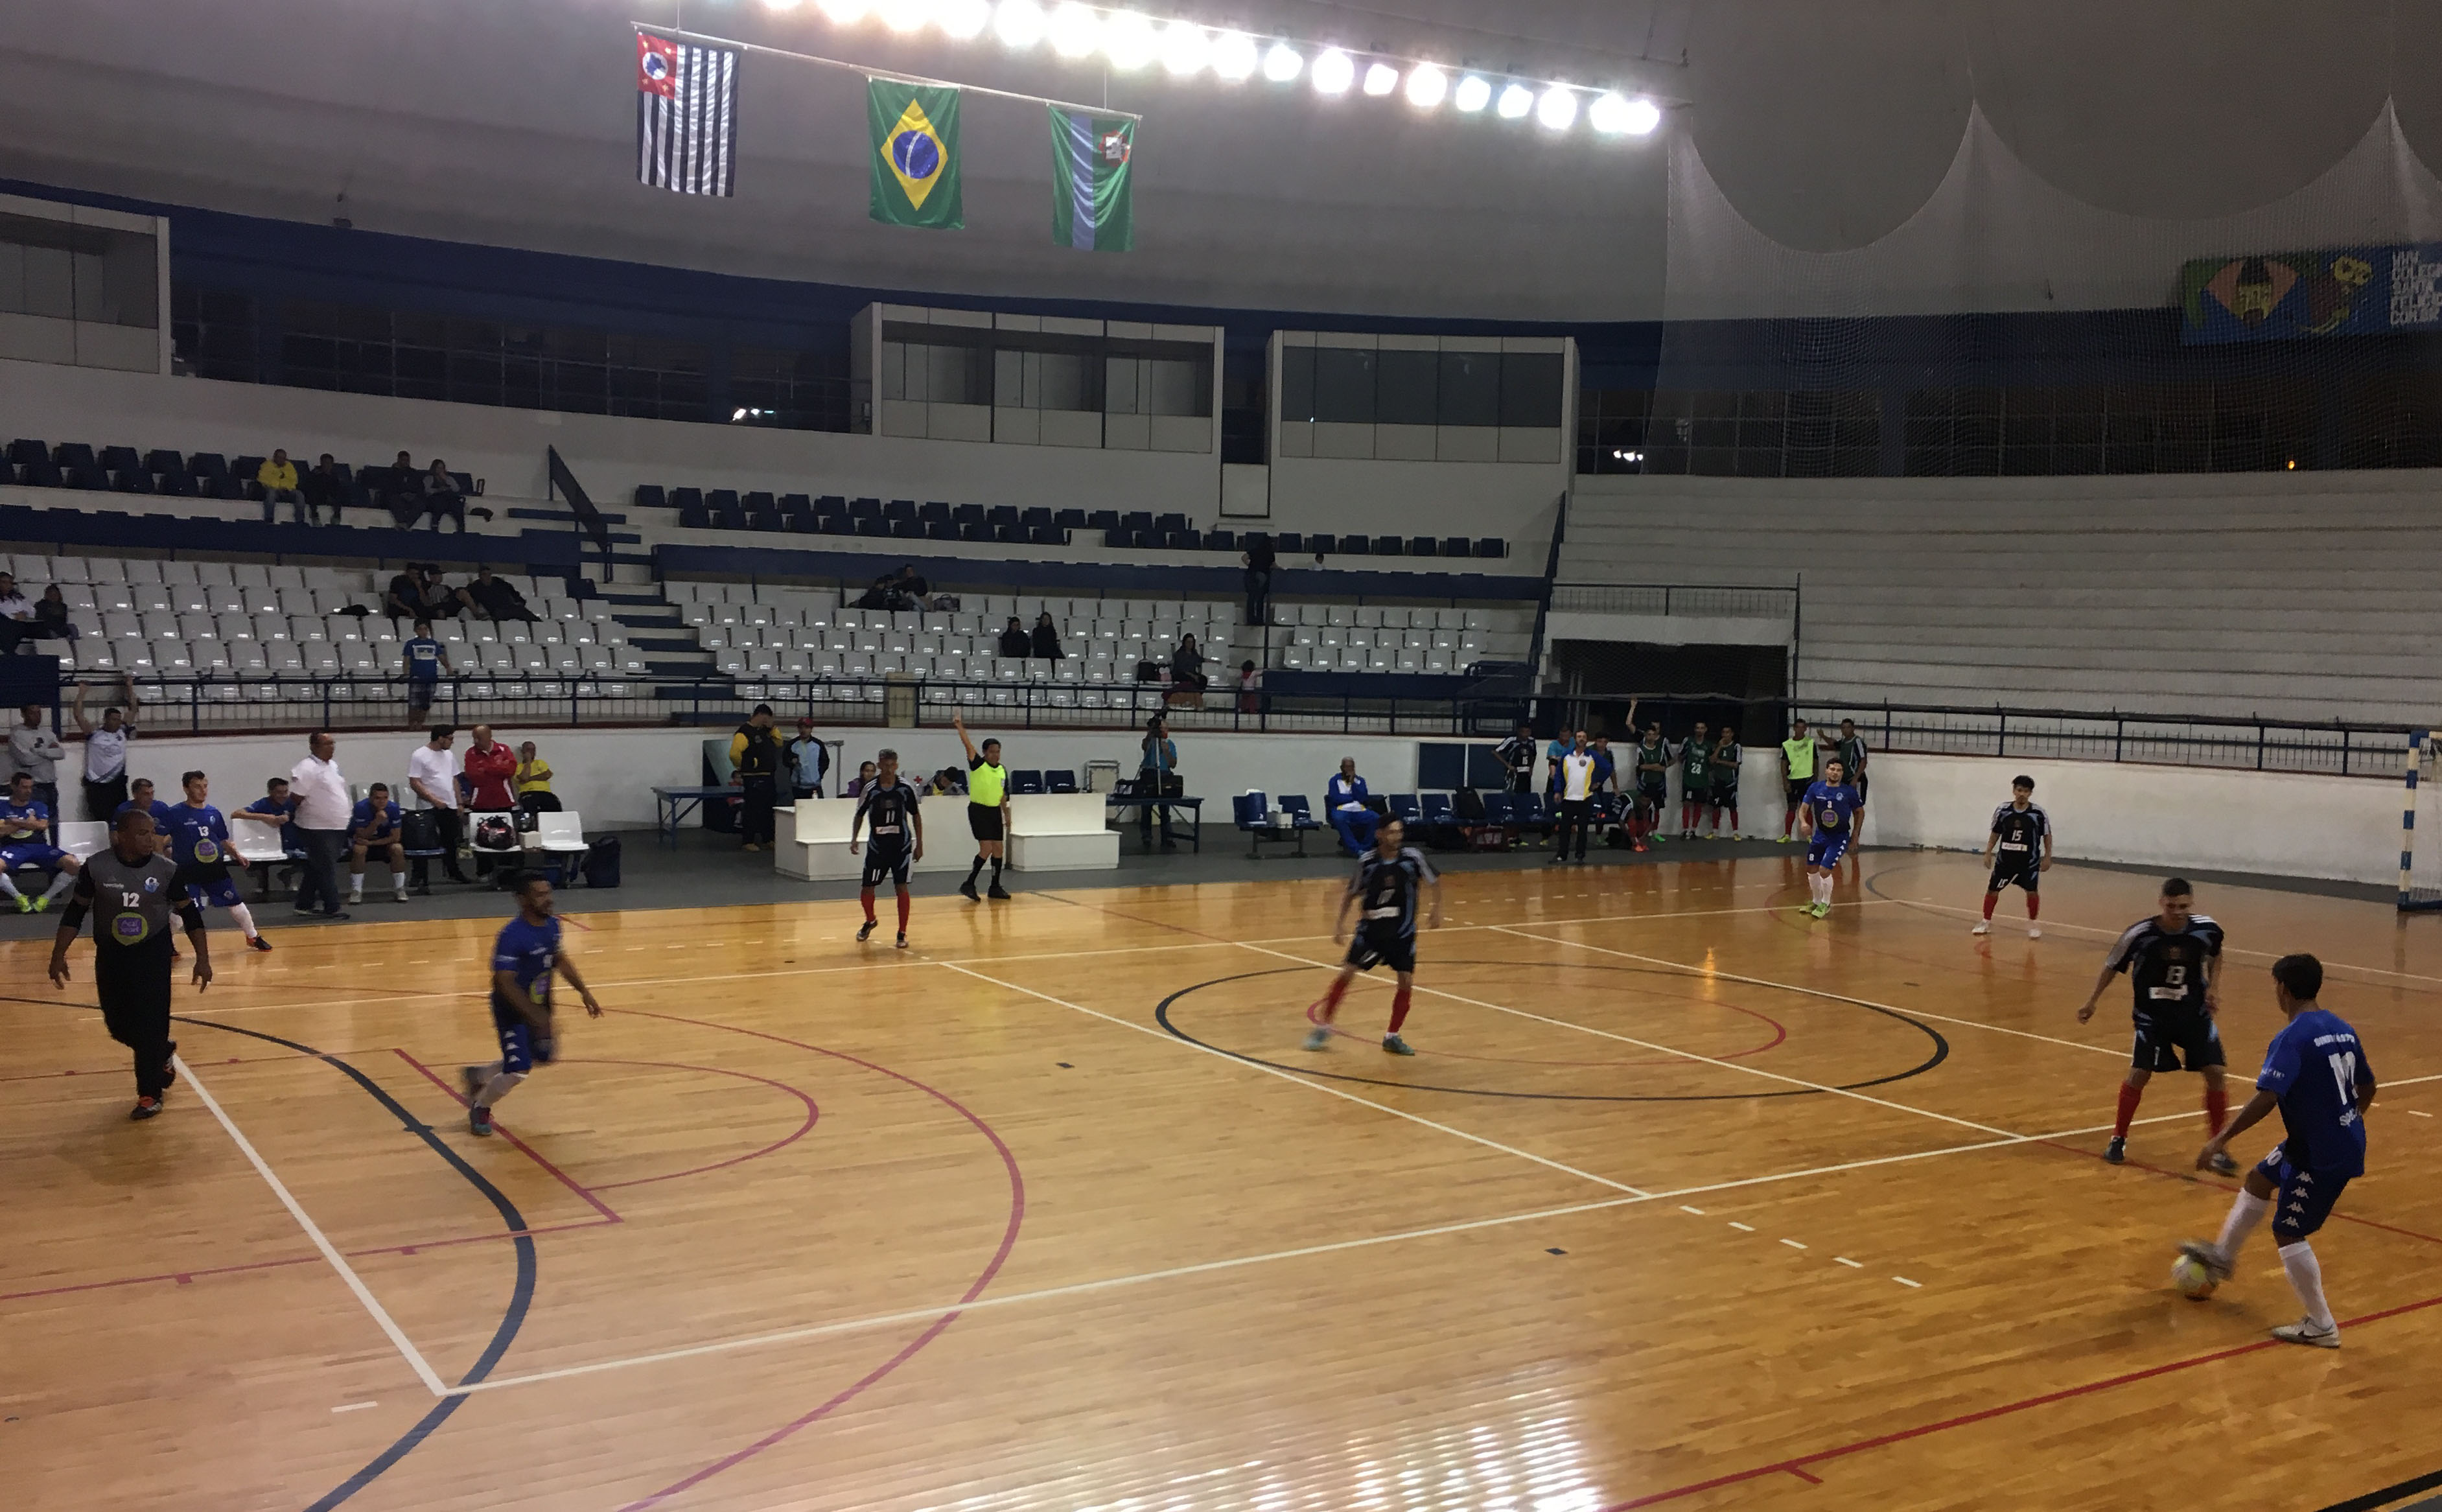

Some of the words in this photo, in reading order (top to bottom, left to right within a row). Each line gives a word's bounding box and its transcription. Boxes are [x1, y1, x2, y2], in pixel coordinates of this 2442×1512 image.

[198, 826, 209, 837] 13
[2012, 830, 2023, 841] 15
[122, 892, 140, 907] 12
